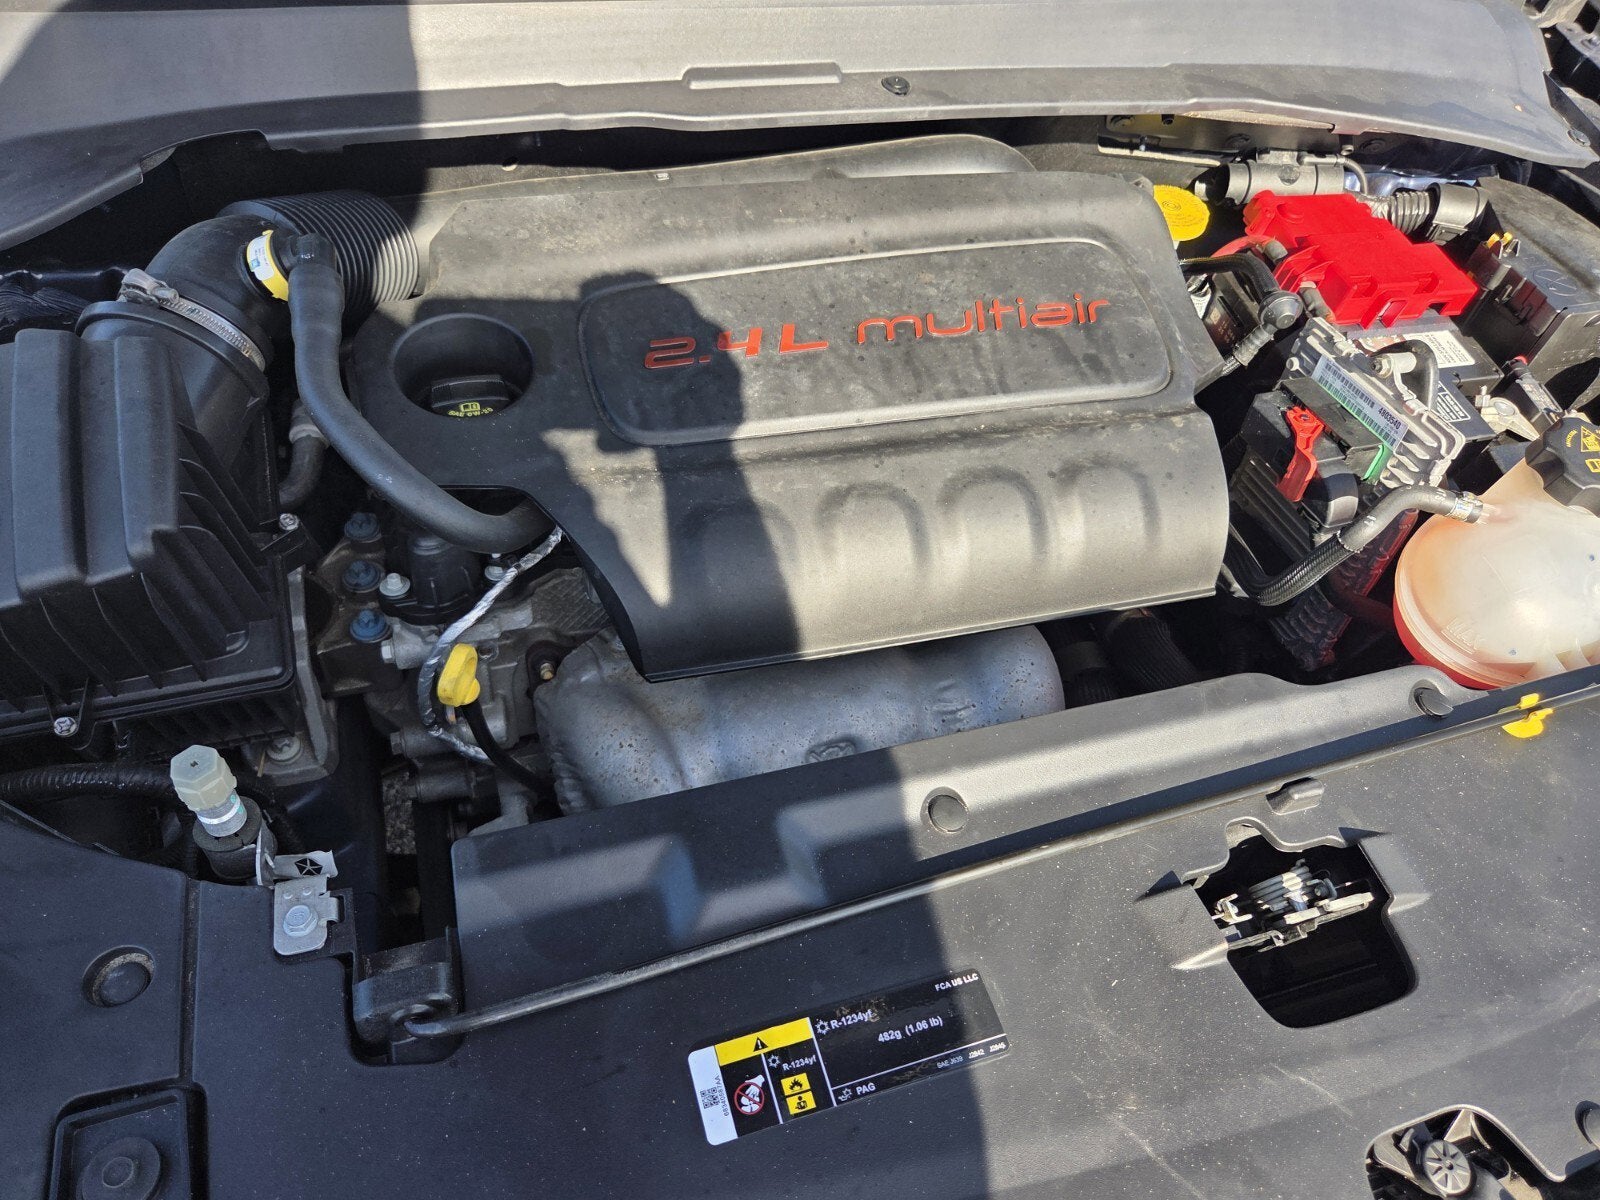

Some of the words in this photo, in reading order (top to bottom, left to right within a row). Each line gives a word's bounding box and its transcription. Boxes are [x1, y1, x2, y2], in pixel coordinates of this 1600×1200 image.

[856, 292, 1112, 344] multiair
[934, 981, 951, 992] FCA
[951, 978, 963, 987] US
[963, 973, 979, 984] LLC
[830, 1008, 873, 1029] R-1234yf
[877, 1030, 902, 1043] 482g
[905, 1020, 928, 1036] (1.06
[928, 1015, 944, 1027] lb)
[782, 1054, 817, 1071] R-1234yf
[936, 1059, 950, 1068] SAE
[855, 1082, 876, 1095] PAG
